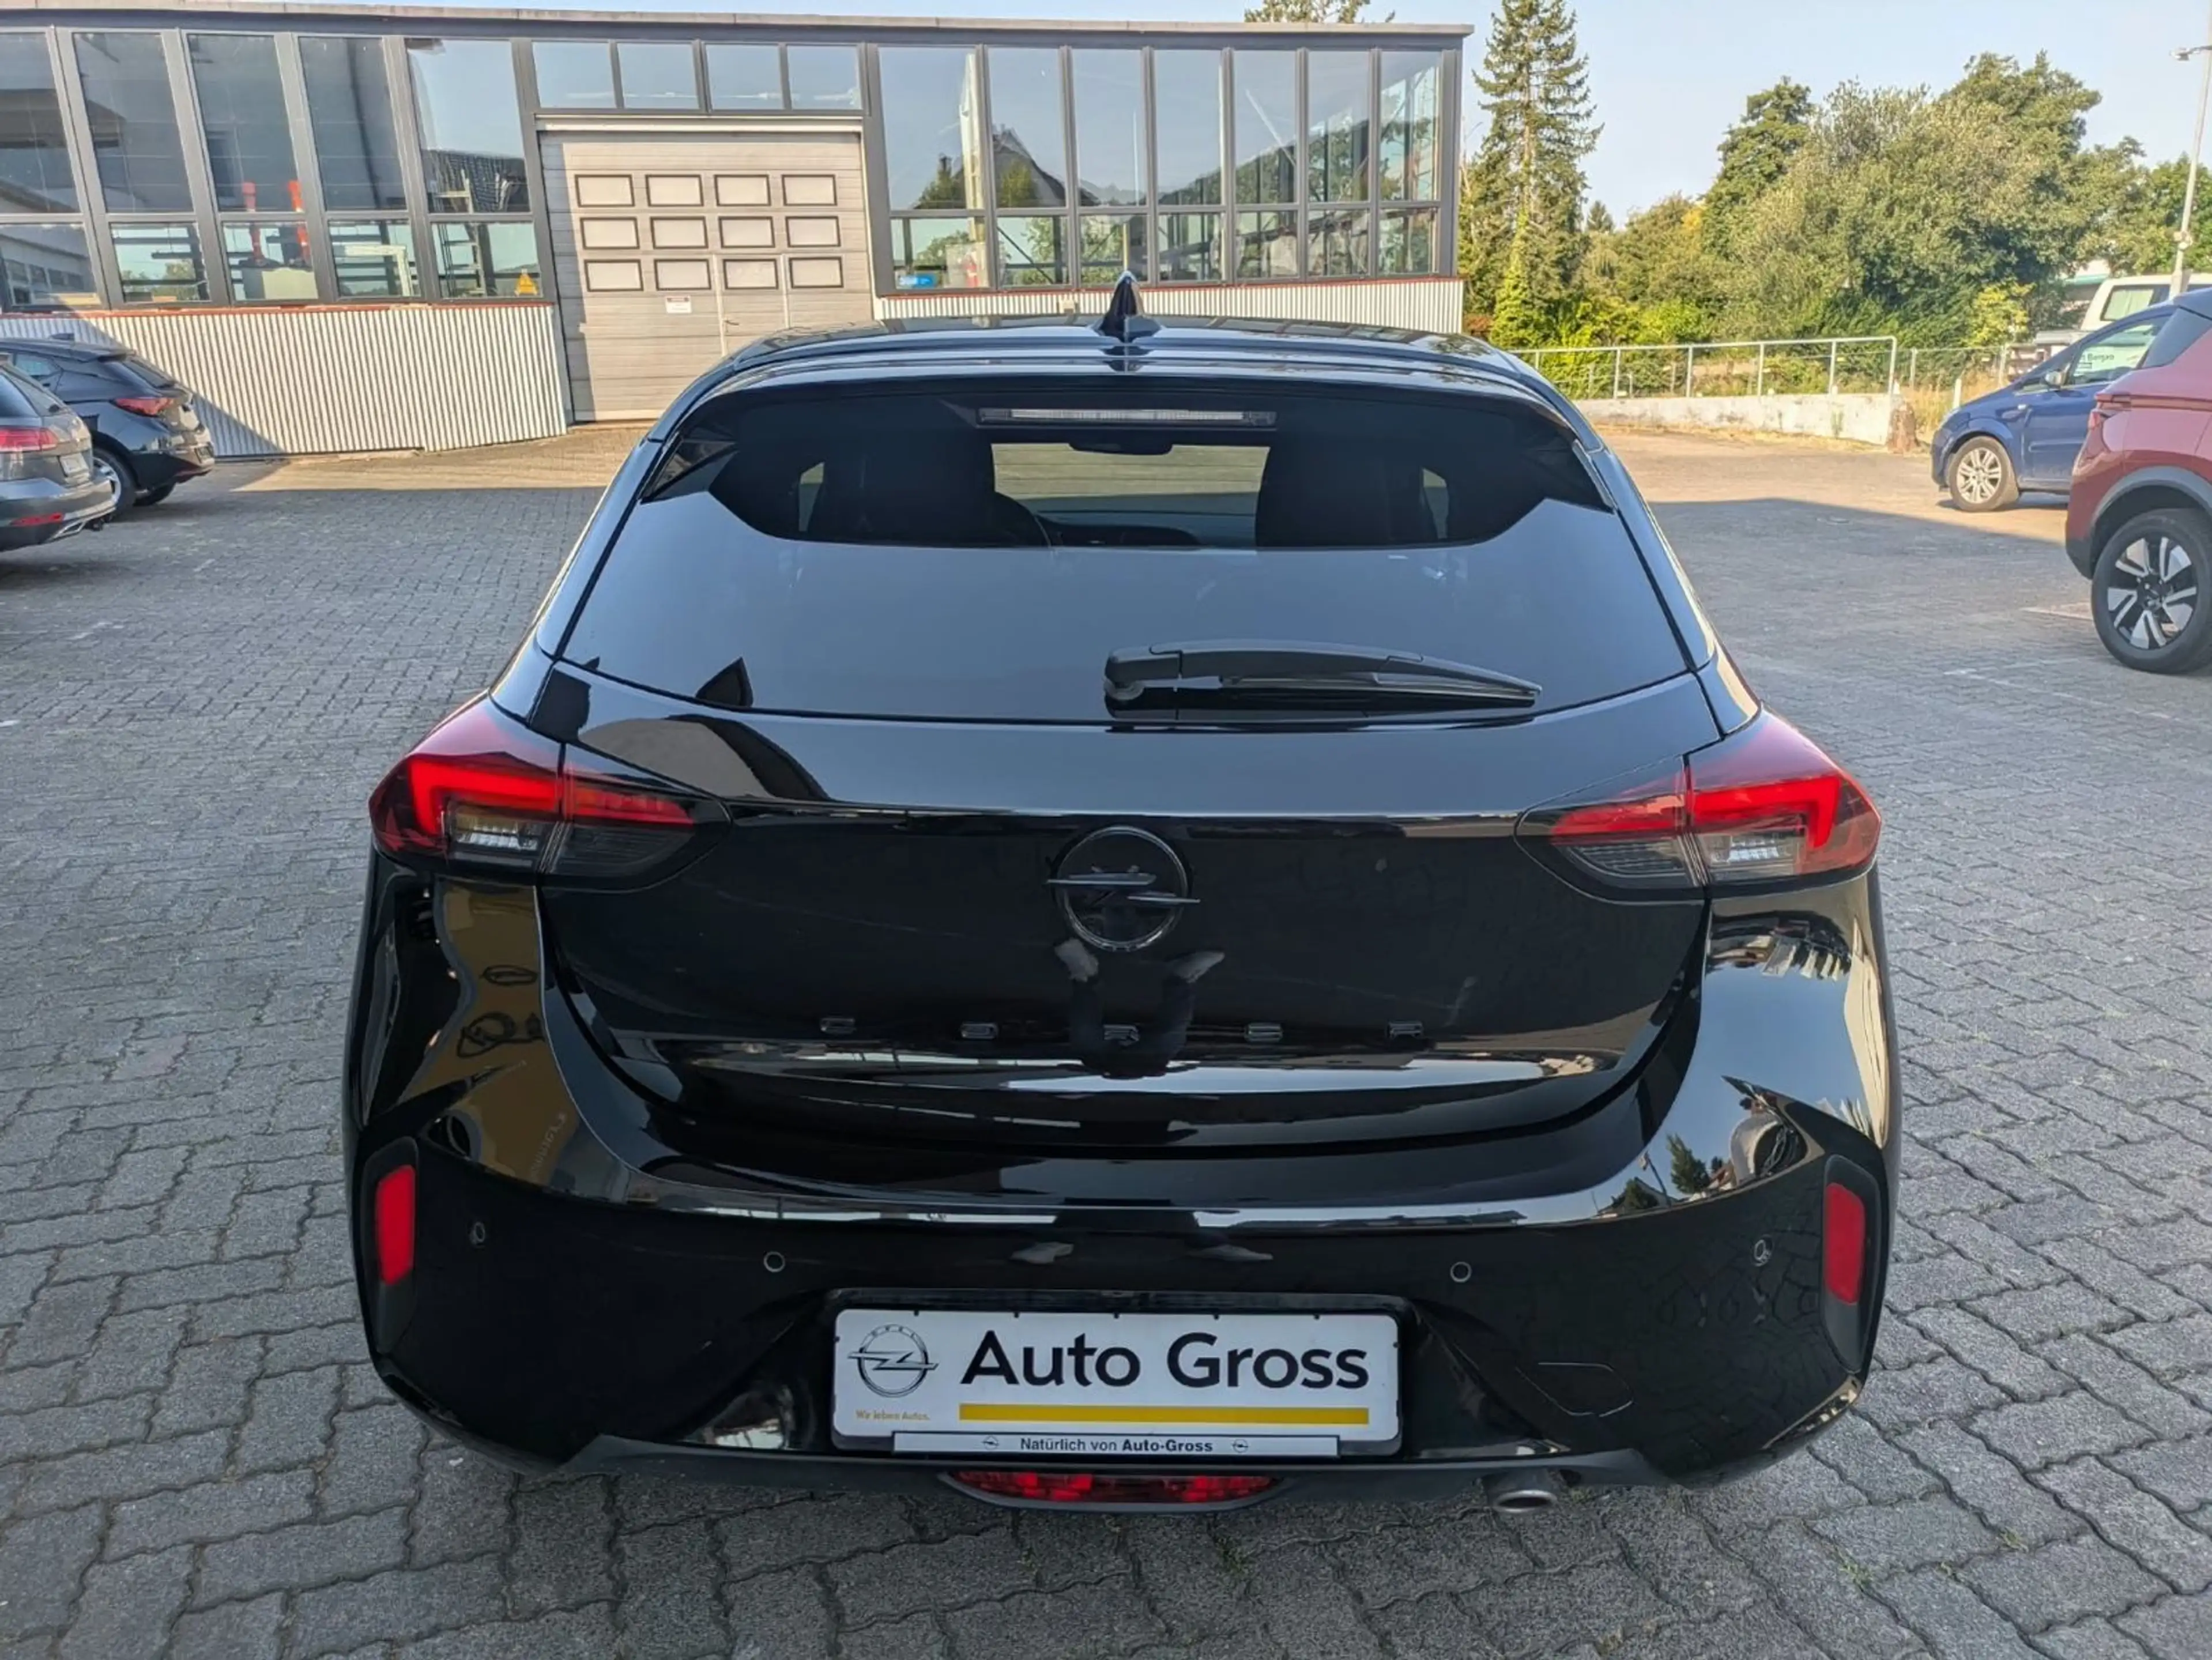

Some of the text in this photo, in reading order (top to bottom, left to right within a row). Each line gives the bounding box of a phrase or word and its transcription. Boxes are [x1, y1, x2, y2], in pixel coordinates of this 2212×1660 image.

[960, 1330, 1141, 1387] Auto
[1166, 1332, 1369, 1389] Gross
[1020, 1438, 1214, 1452] Natürlich von Auto-Gross
